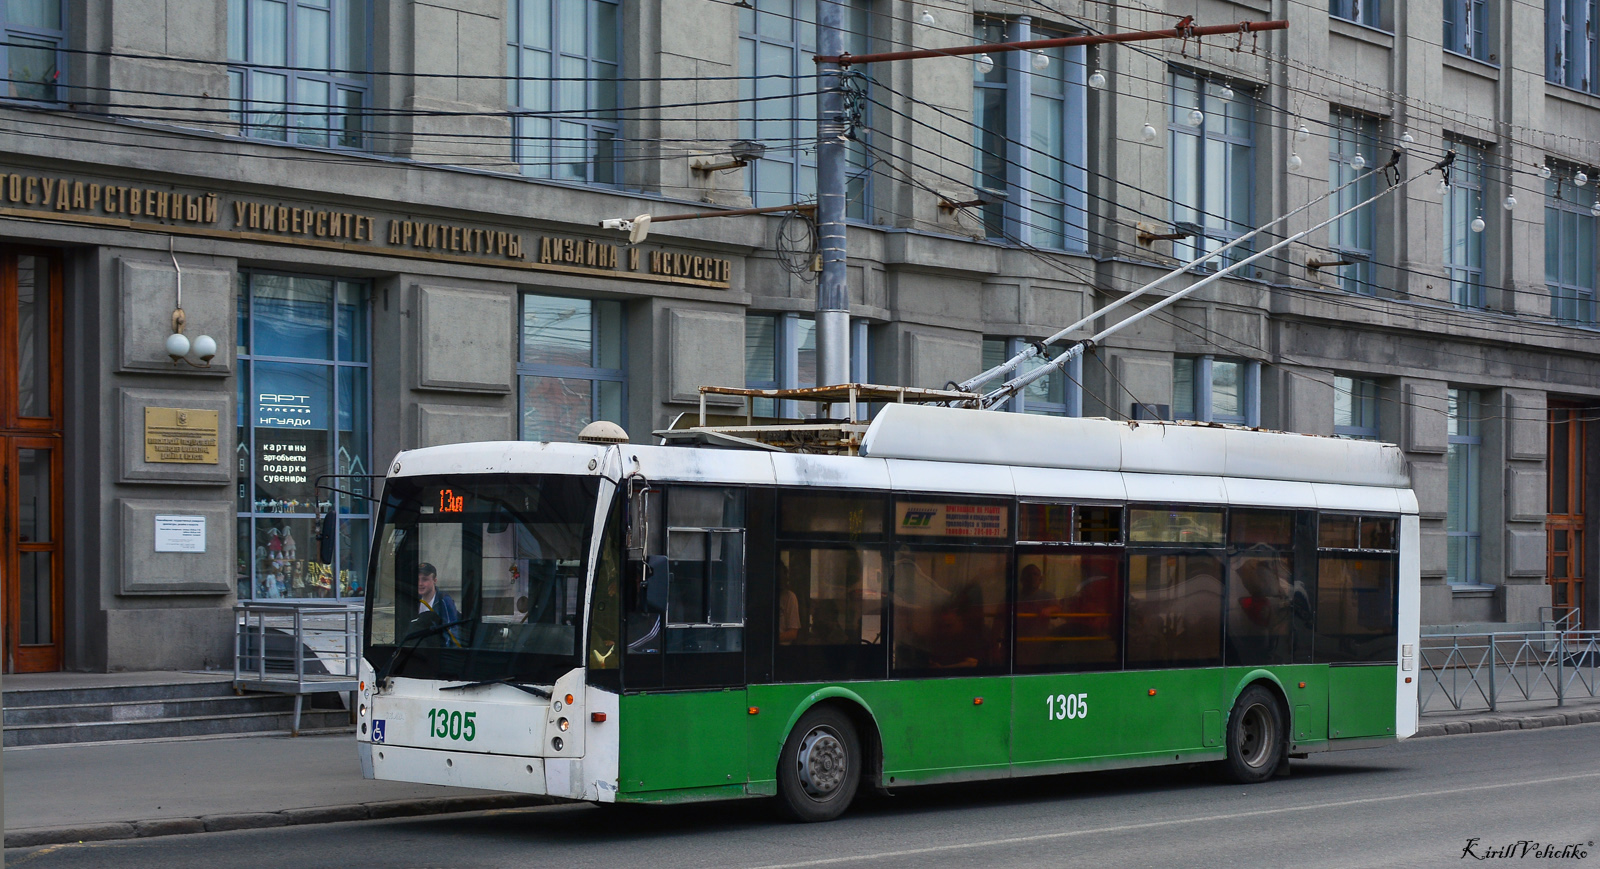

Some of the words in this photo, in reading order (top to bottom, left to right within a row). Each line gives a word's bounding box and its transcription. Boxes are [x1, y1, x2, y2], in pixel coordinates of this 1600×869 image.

[234, 200, 376, 241] УНИВЕРСИТЕТ
[539, 236, 619, 268] ДИЗАЙНА
[629, 247, 640, 270] И
[651, 250, 732, 281] ИСКУССТВ
[260, 393, 310, 404] АРТ
[260, 417, 311, 427] НГУАДИ
[263, 443, 307, 453] картины
[263, 454, 307, 463] арт-объекты
[263, 464, 307, 474] подарки
[263, 474, 307, 484] сувениры
[1046, 693, 1088, 721] 1305
[428, 708, 476, 742] 1305
